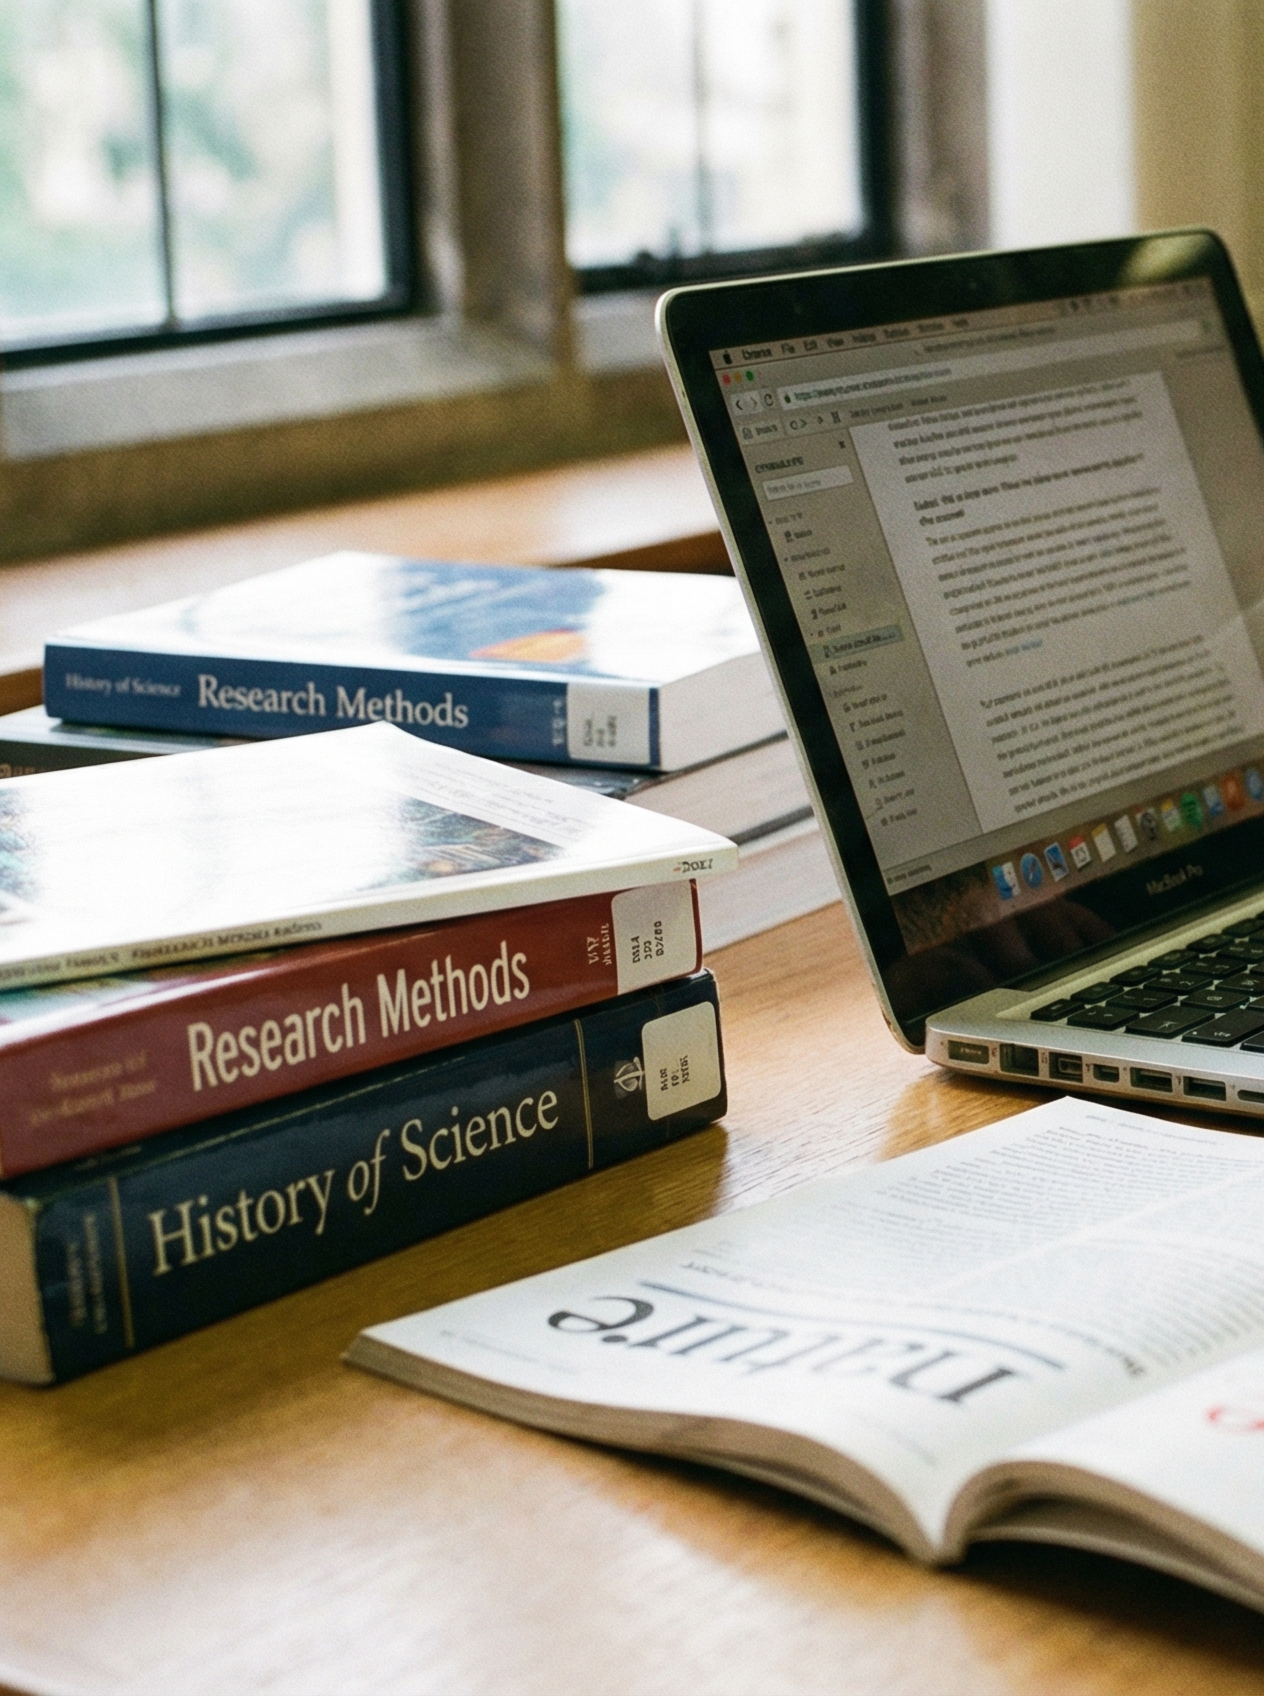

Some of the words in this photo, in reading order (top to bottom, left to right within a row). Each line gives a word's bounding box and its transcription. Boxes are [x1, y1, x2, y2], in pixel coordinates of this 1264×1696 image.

[65, 672, 113, 697] History
[115, 675, 132, 695] of
[132, 677, 182, 699] Science
[197, 674, 327, 717] Research
[335, 685, 470, 729] Methods
[187, 992, 366, 1093] Research
[376, 940, 531, 1039] Methods
[148, 1167, 334, 1277] History
[346, 1128, 391, 1215] of
[400, 1090, 560, 1183] Science
[546, 1293, 1032, 1406] nature
